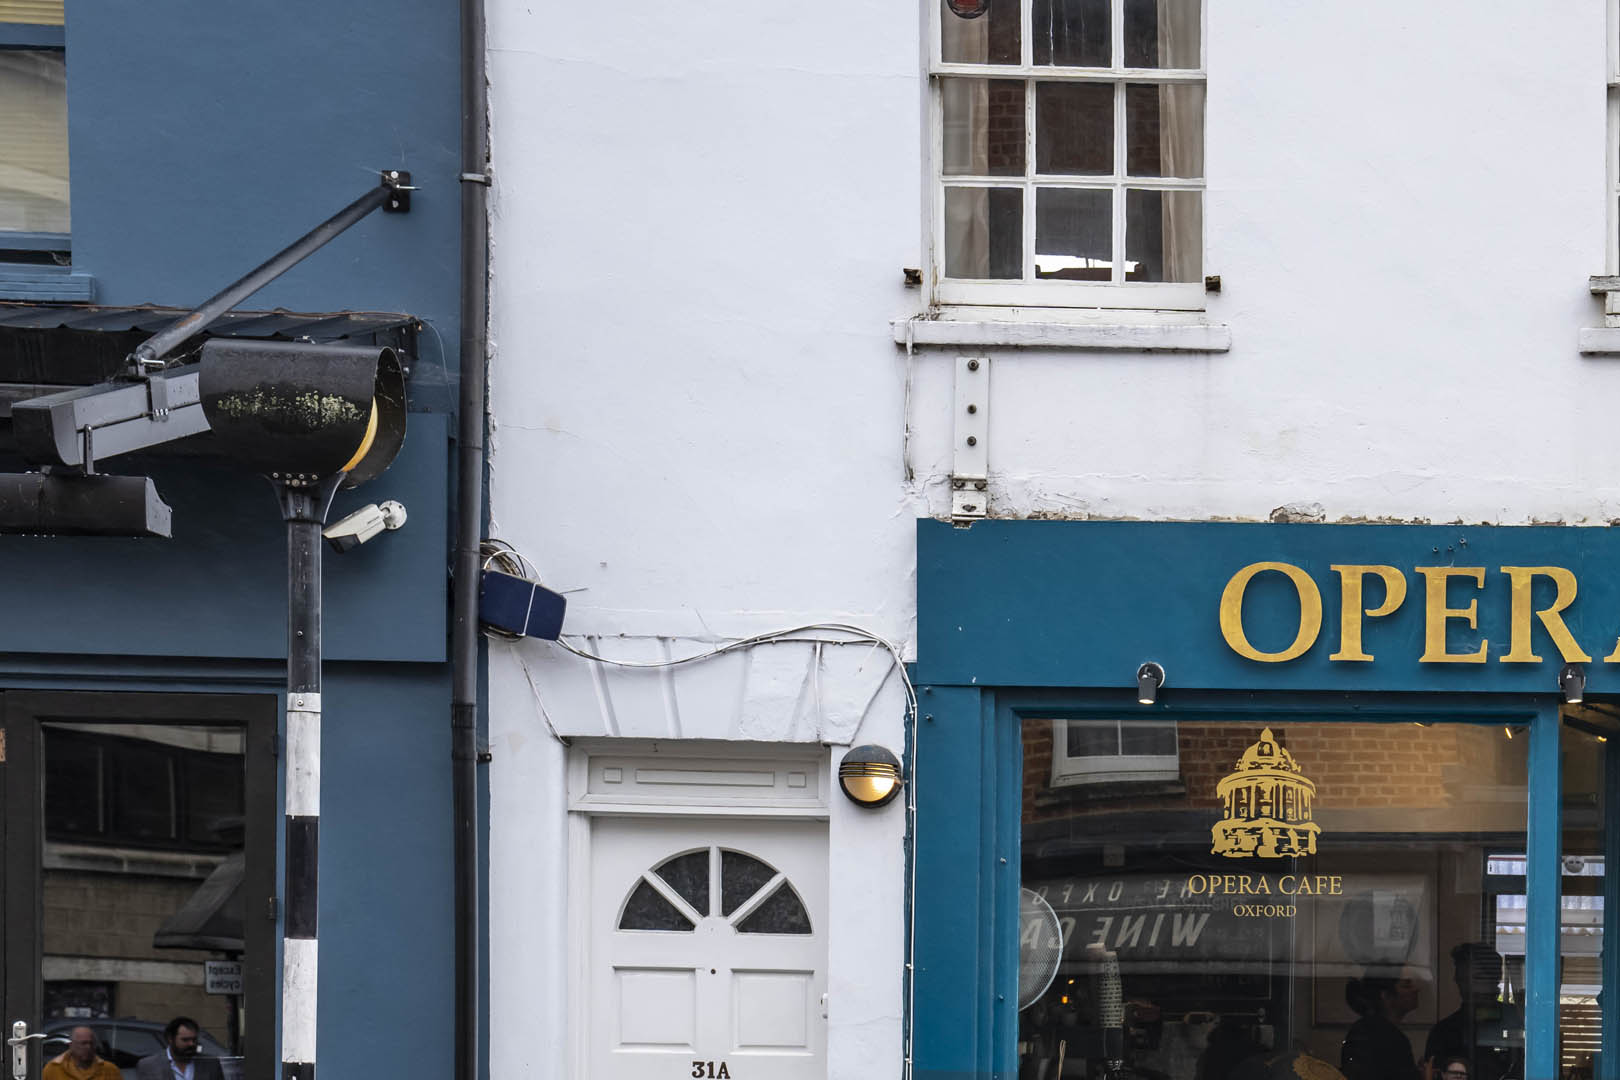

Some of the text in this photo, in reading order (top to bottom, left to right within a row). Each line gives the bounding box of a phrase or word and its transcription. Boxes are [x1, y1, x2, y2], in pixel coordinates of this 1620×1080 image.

[1188, 874, 1343, 896] OPERA CAFE
[1233, 904, 1297, 918] OXFORD
[691, 1061, 731, 1079] 31A
